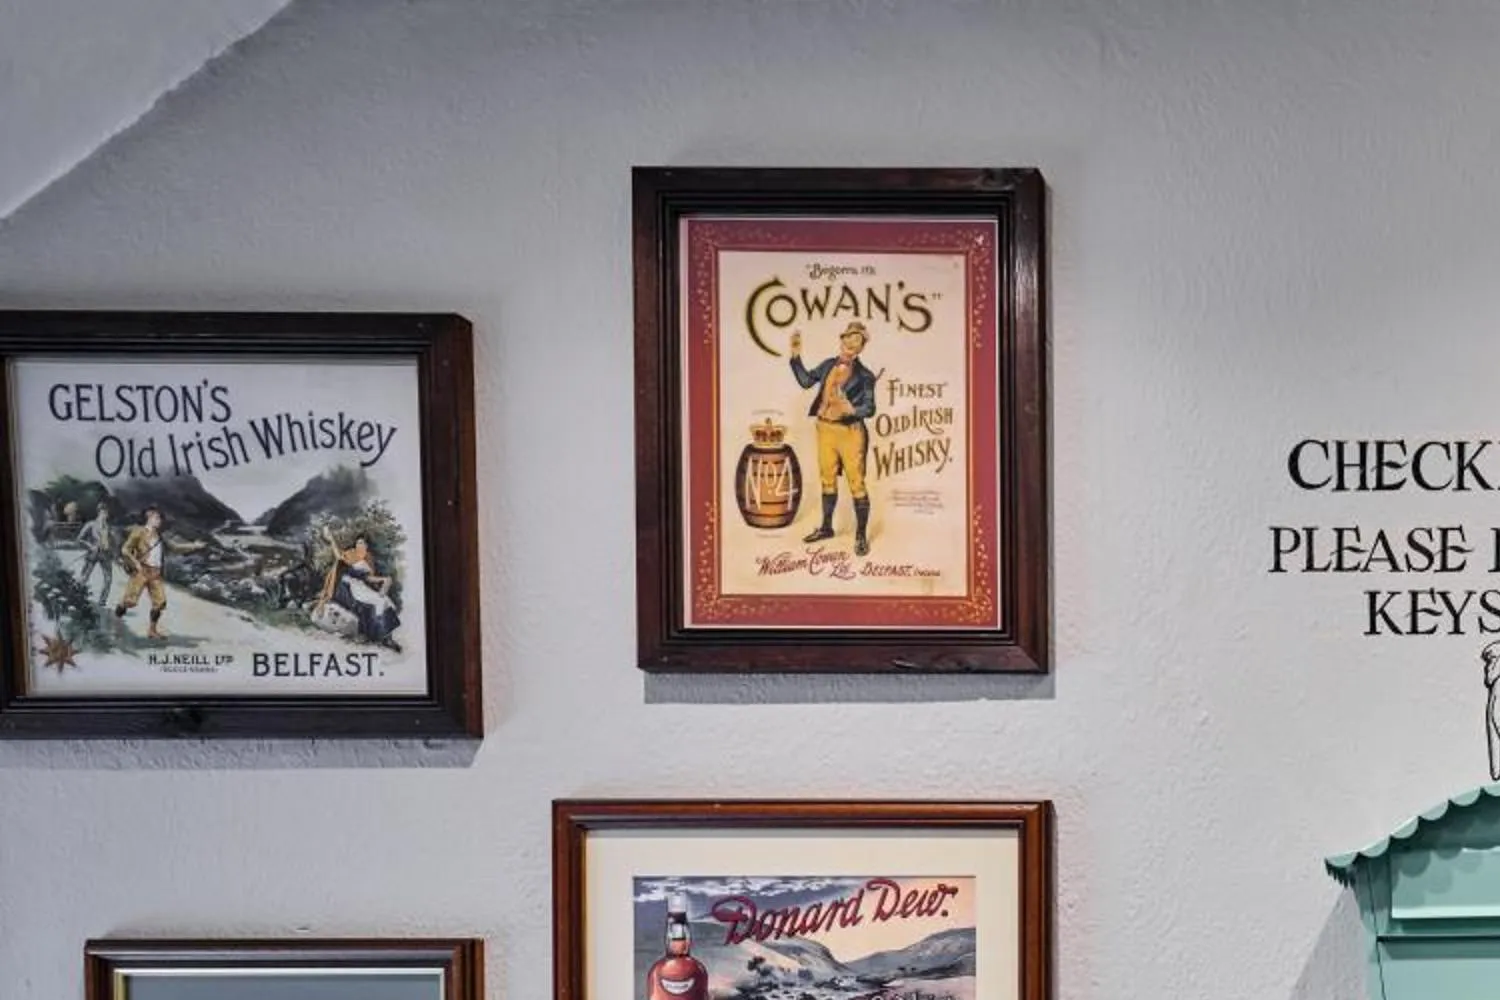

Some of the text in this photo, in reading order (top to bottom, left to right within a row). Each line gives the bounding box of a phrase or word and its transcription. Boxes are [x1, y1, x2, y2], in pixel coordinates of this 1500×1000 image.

[48, 379, 233, 424] GELSTON'S
[887, 379, 947, 406] FINEST
[876, 404, 954, 437] OLD IRISH
[95, 410, 398, 478] Old Irish Whiskey
[1267, 523, 1476, 574] PLEASE
[252, 652, 385, 677] BELFAST.
[711, 888, 865, 945] Donard
